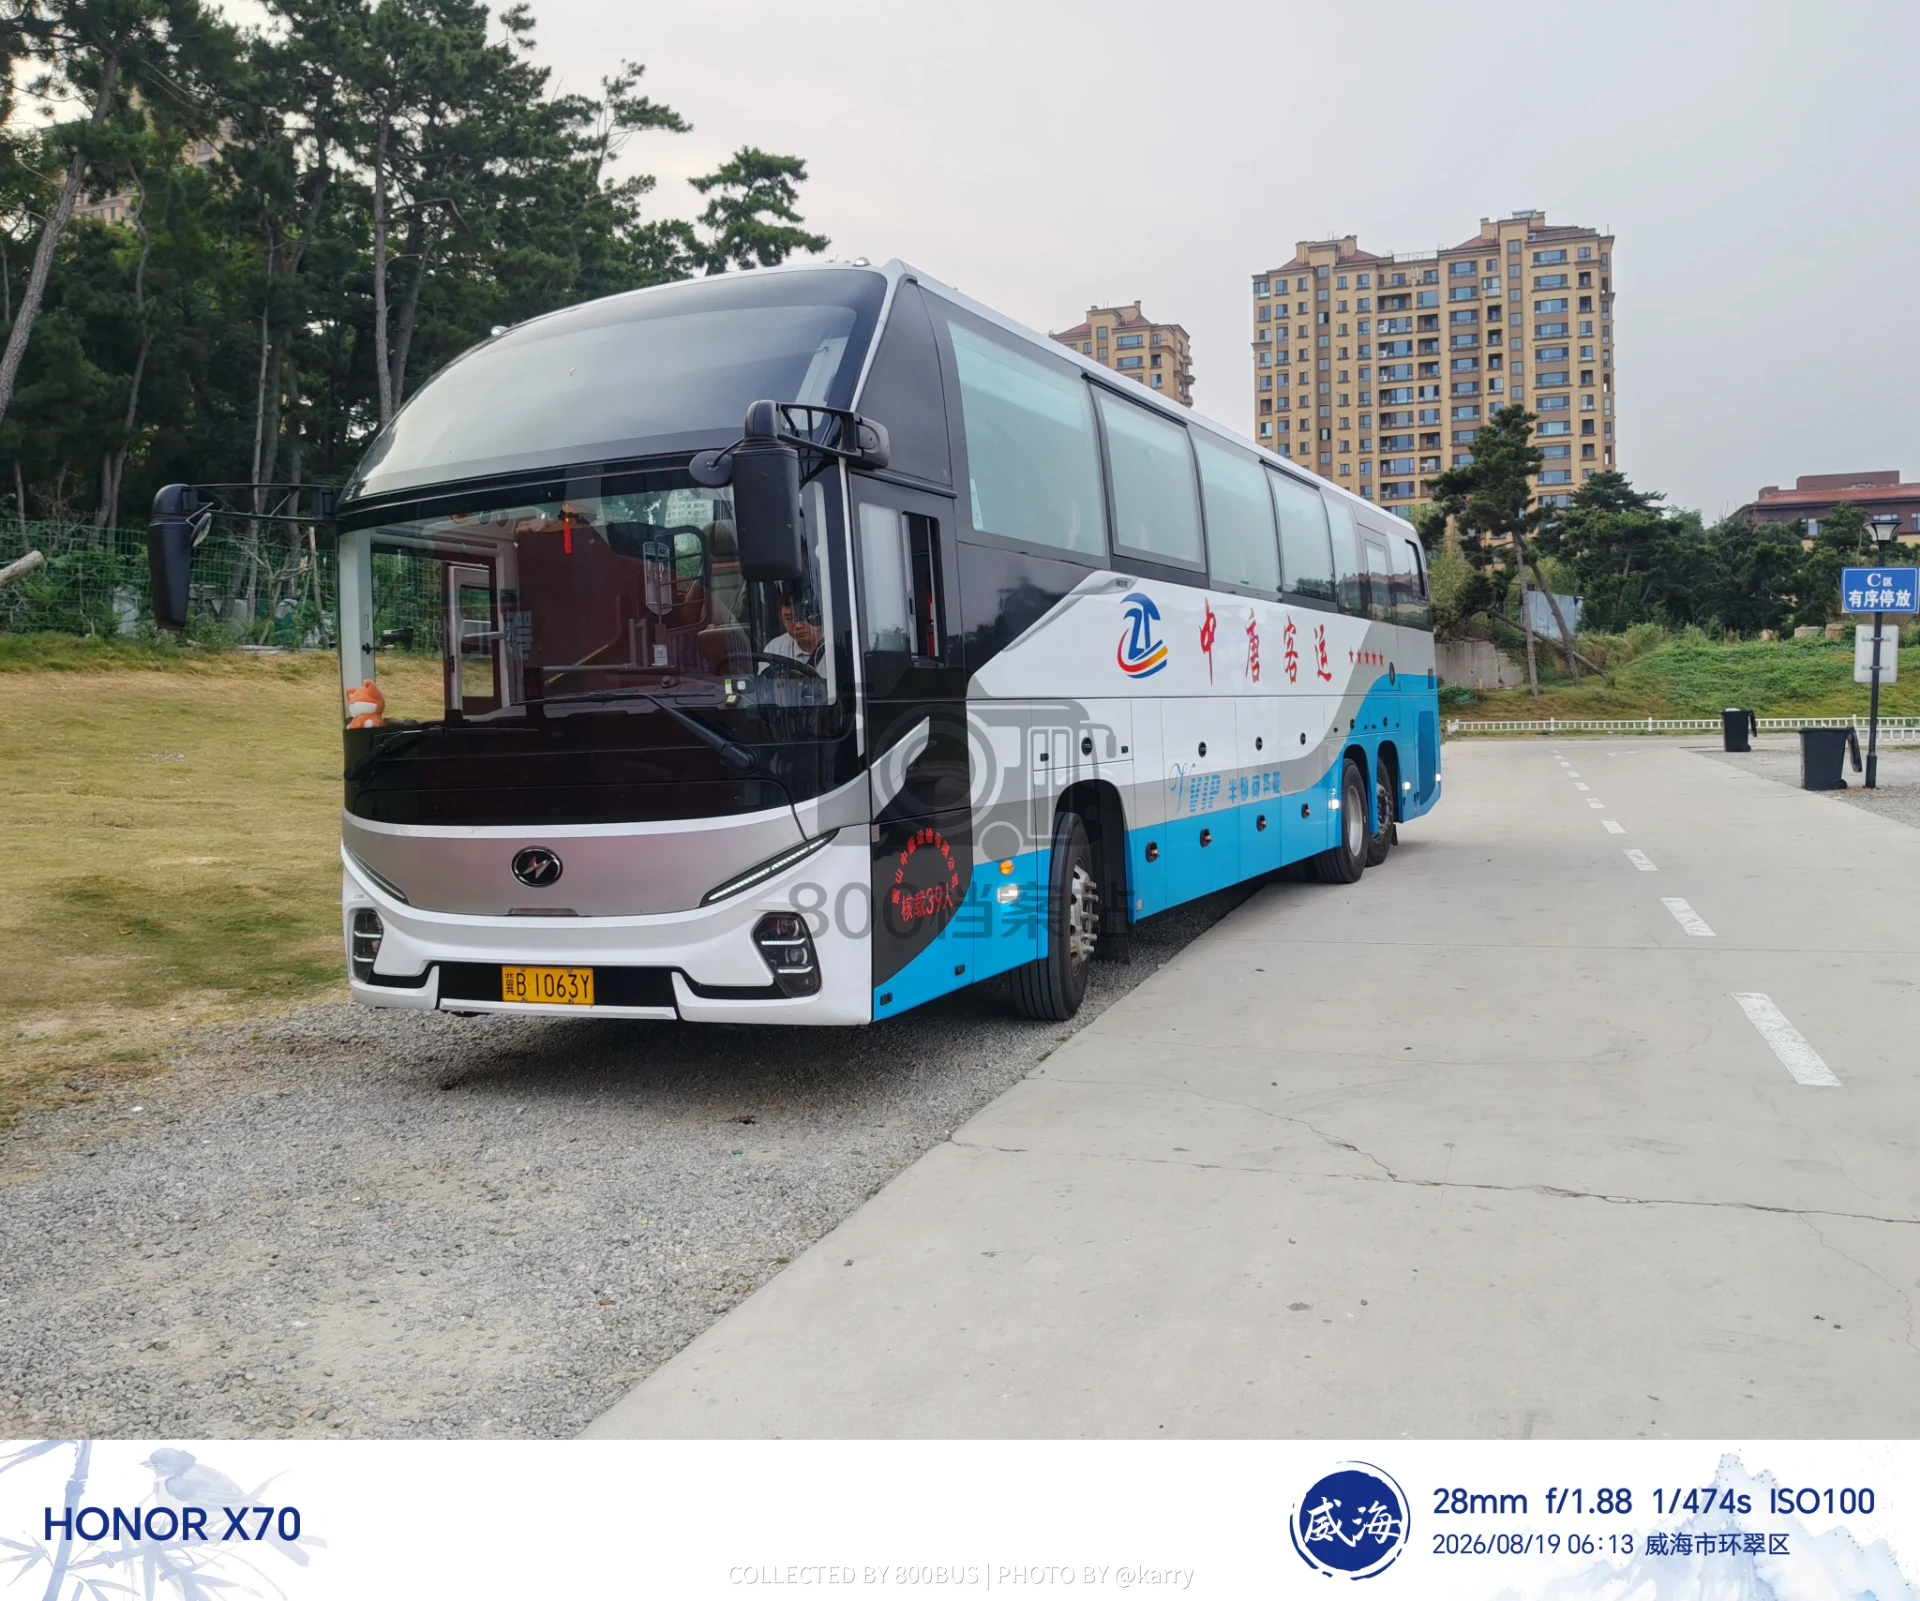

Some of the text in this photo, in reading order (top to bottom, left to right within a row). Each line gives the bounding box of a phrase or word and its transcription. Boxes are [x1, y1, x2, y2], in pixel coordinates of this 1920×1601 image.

[1848, 589, 1911, 608] 有序停放
[1199, 597, 1332, 686] 中唐客运
[901, 883, 954, 923] 核载39人
